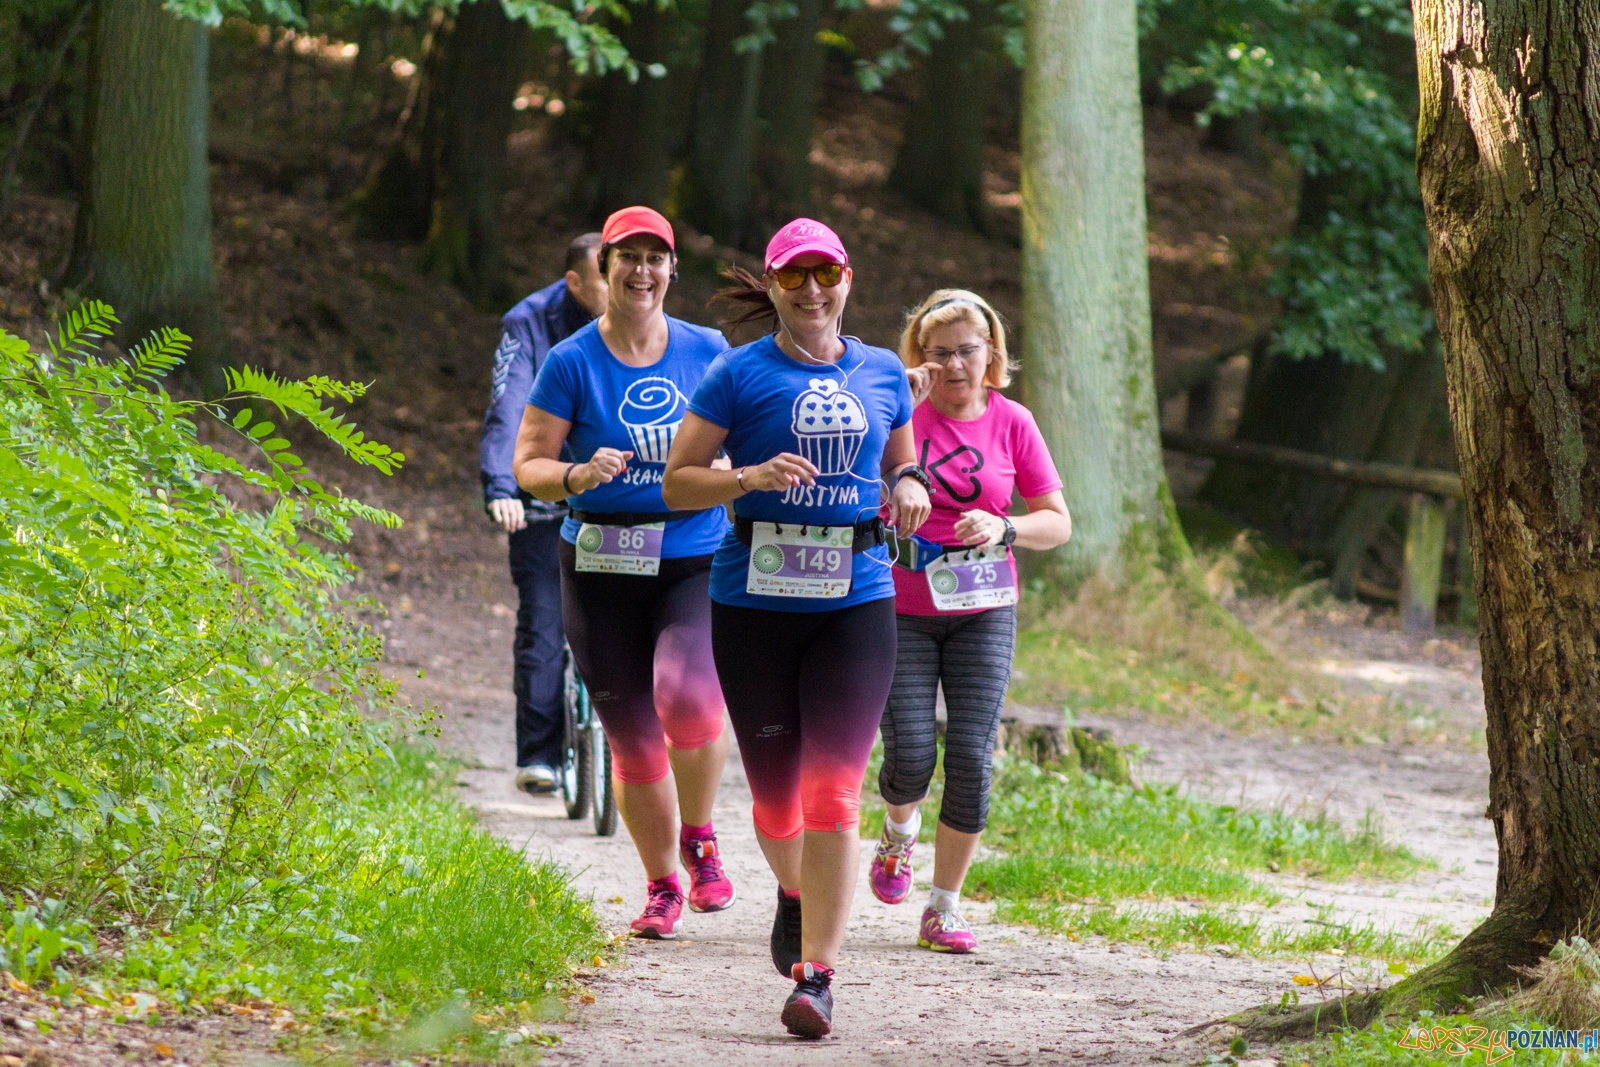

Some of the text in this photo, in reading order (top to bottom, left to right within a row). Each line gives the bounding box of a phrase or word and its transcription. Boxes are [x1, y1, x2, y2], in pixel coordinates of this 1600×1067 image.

[780, 484, 859, 507] JUSTYNA
[617, 528, 645, 550] 86
[795, 548, 841, 572] 149
[971, 563, 998, 584] 25
